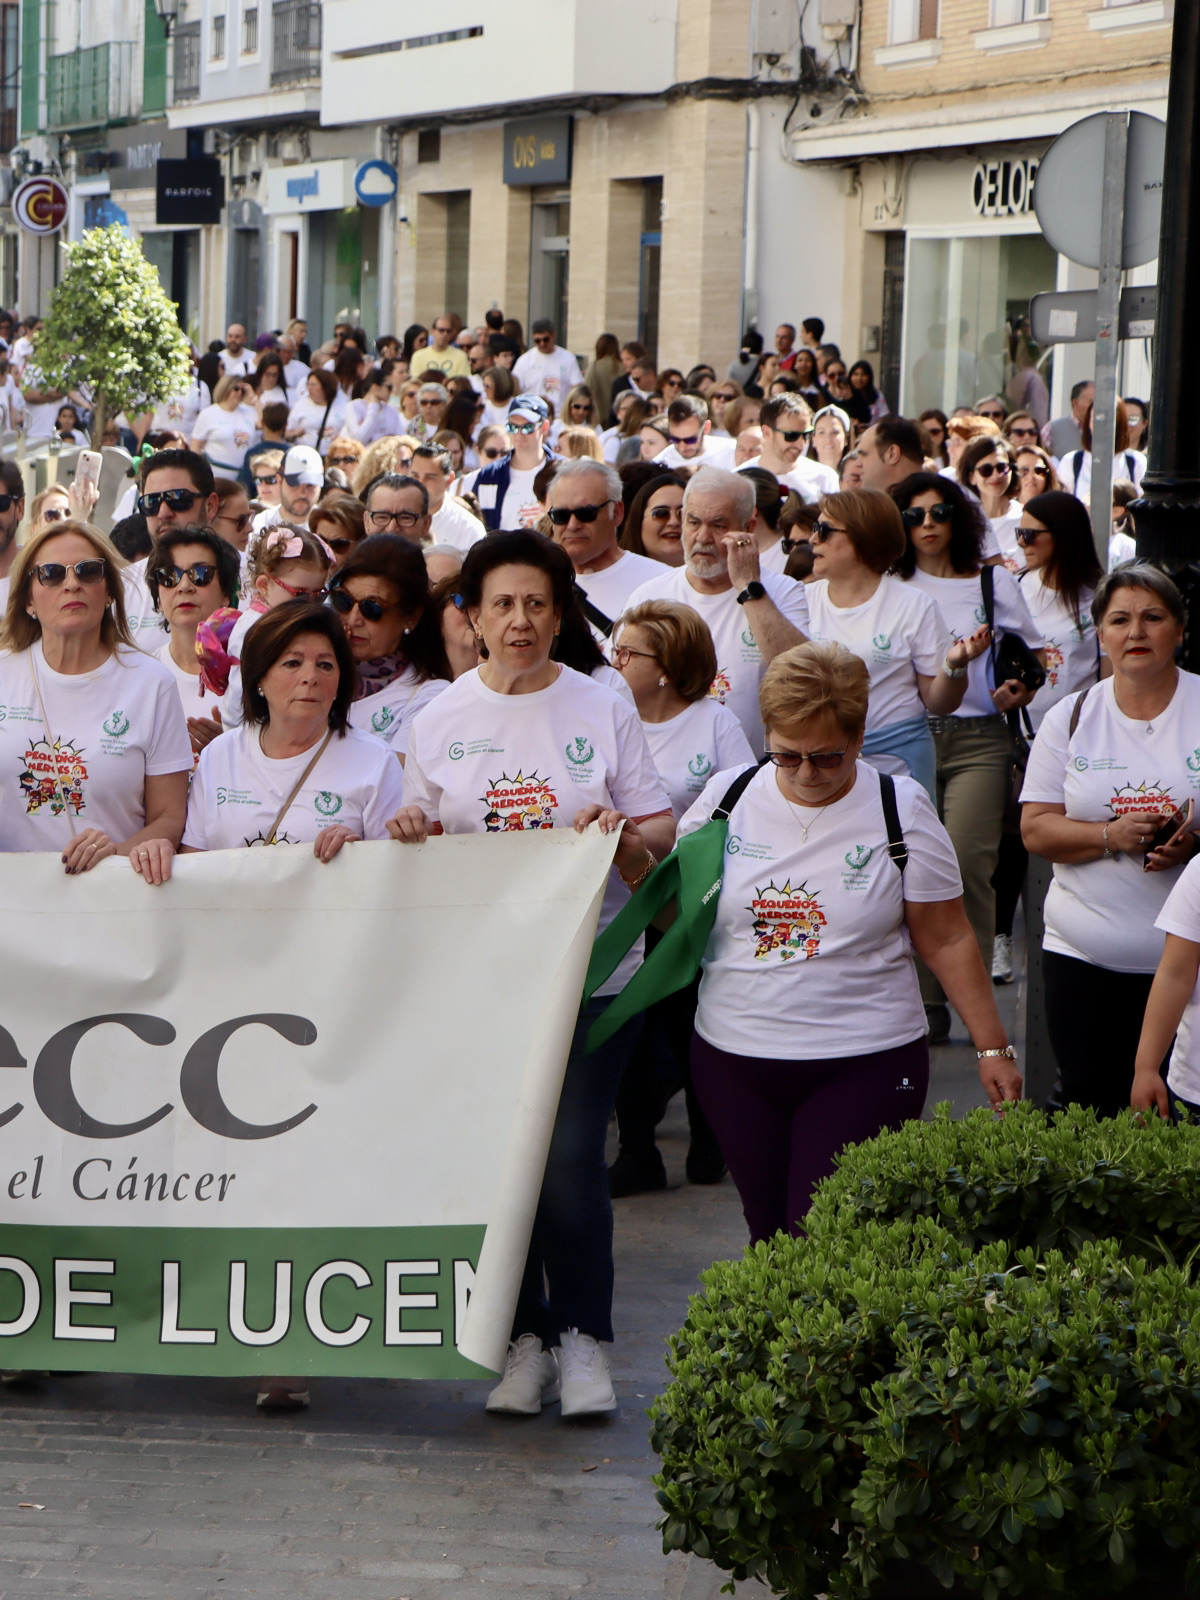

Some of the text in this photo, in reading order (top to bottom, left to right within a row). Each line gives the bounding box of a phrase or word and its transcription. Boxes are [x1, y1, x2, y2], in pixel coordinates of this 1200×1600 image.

[512, 134, 536, 168] OVS
[486, 783, 550, 799] PEQUEÑOS
[1111, 792, 1172, 805] PEQUEÑOS
[752, 896, 819, 909] PEQUEÑOS
[7, 1155, 44, 1200] el
[72, 1156, 236, 1203] Cáncer
